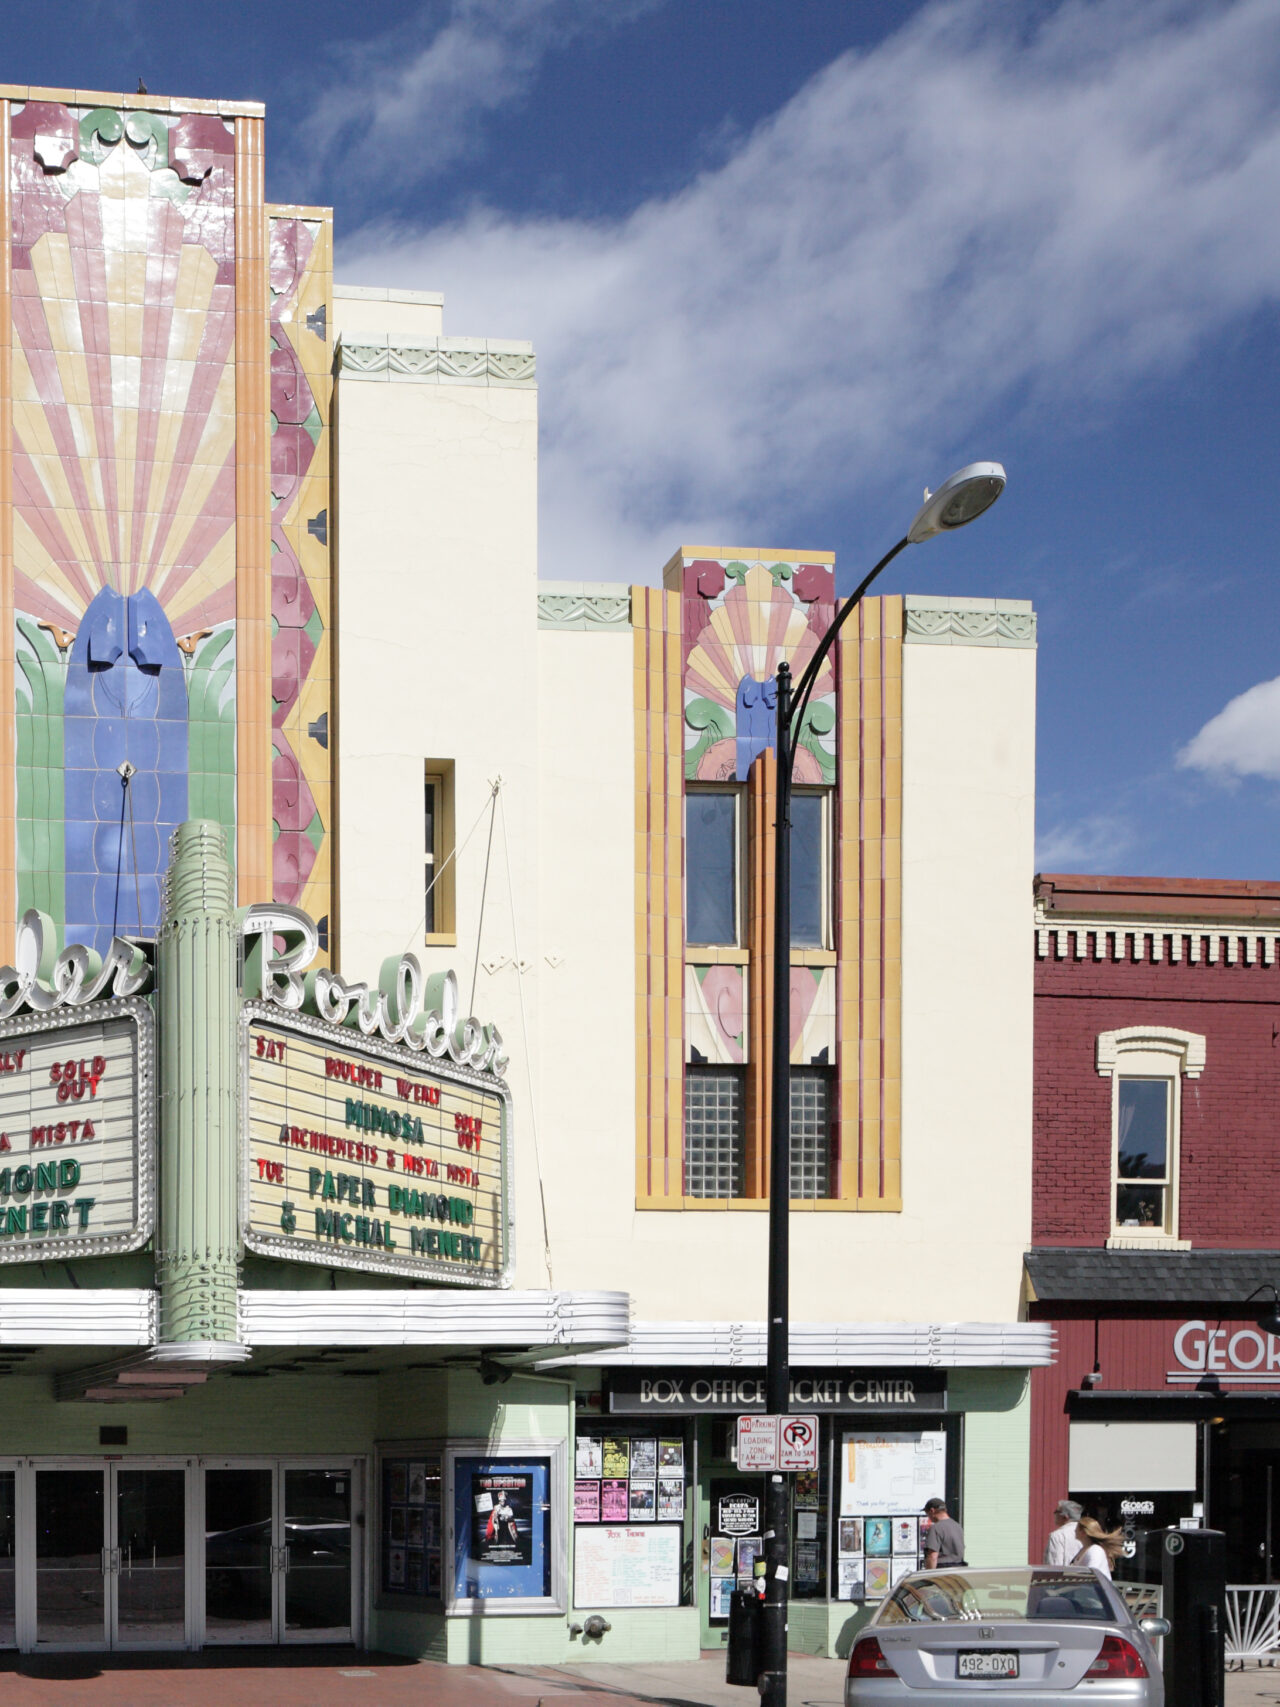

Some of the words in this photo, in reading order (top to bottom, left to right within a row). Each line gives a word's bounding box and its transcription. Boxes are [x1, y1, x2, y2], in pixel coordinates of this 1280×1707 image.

[236, 903, 510, 1077] Boulder
[256, 1036, 287, 1062] SAT
[50, 1055, 106, 1081] SOLD
[325, 1057, 383, 1088] BOULDER
[57, 1075, 100, 1101] OUT
[31, 1119, 96, 1148] MISTA
[345, 1098, 425, 1145] MIMOSA
[454, 1112, 483, 1132] SOLD
[457, 1131, 482, 1152] OUT
[257, 1158, 285, 1184] TUE
[386, 1149, 396, 1169] &
[402, 1153, 439, 1178] MISTA
[446, 1164, 479, 1188] MISTA
[308, 1167, 377, 1209] PAPER
[388, 1184, 473, 1227] DIAMOND
[281, 1200, 296, 1234] &
[315, 1207, 397, 1249] MICHAL
[410, 1225, 483, 1263] MENERT
[640, 1380, 684, 1402] BOX
[690, 1380, 765, 1403] OFFICE
[789, 1380, 843, 1403] ICKET
[848, 1380, 916, 1403] CENTER
[740, 1418, 751, 1432] NO
